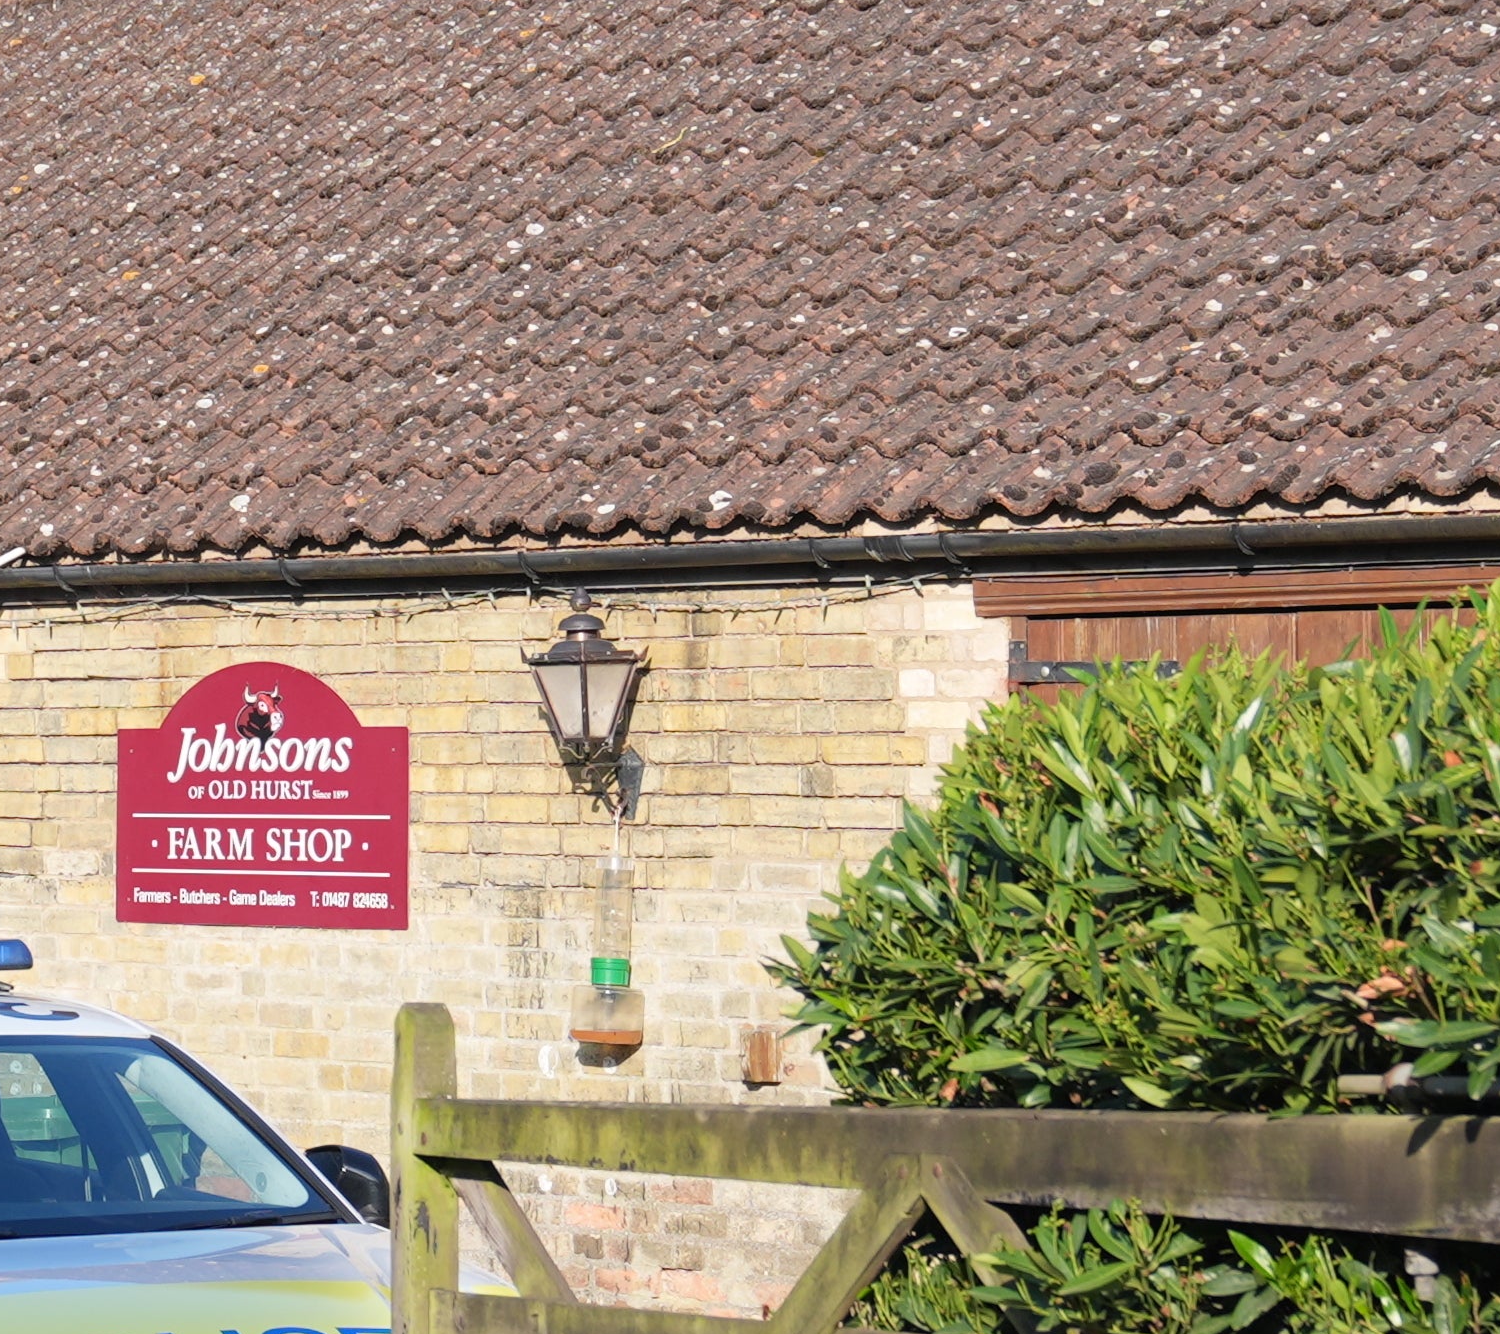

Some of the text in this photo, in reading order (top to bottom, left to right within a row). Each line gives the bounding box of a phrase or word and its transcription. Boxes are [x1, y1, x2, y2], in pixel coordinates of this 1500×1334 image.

[167, 723, 353, 783] Johnsons
[188, 786, 205, 800] OF
[208, 779, 247, 800] OLD
[250, 780, 313, 800] HURST
[312, 789, 332, 800] Since
[167, 827, 352, 863] FARM SHOP
[133, 887, 389, 909] Farmers Butchers Game Dealers T: 01487 824658
